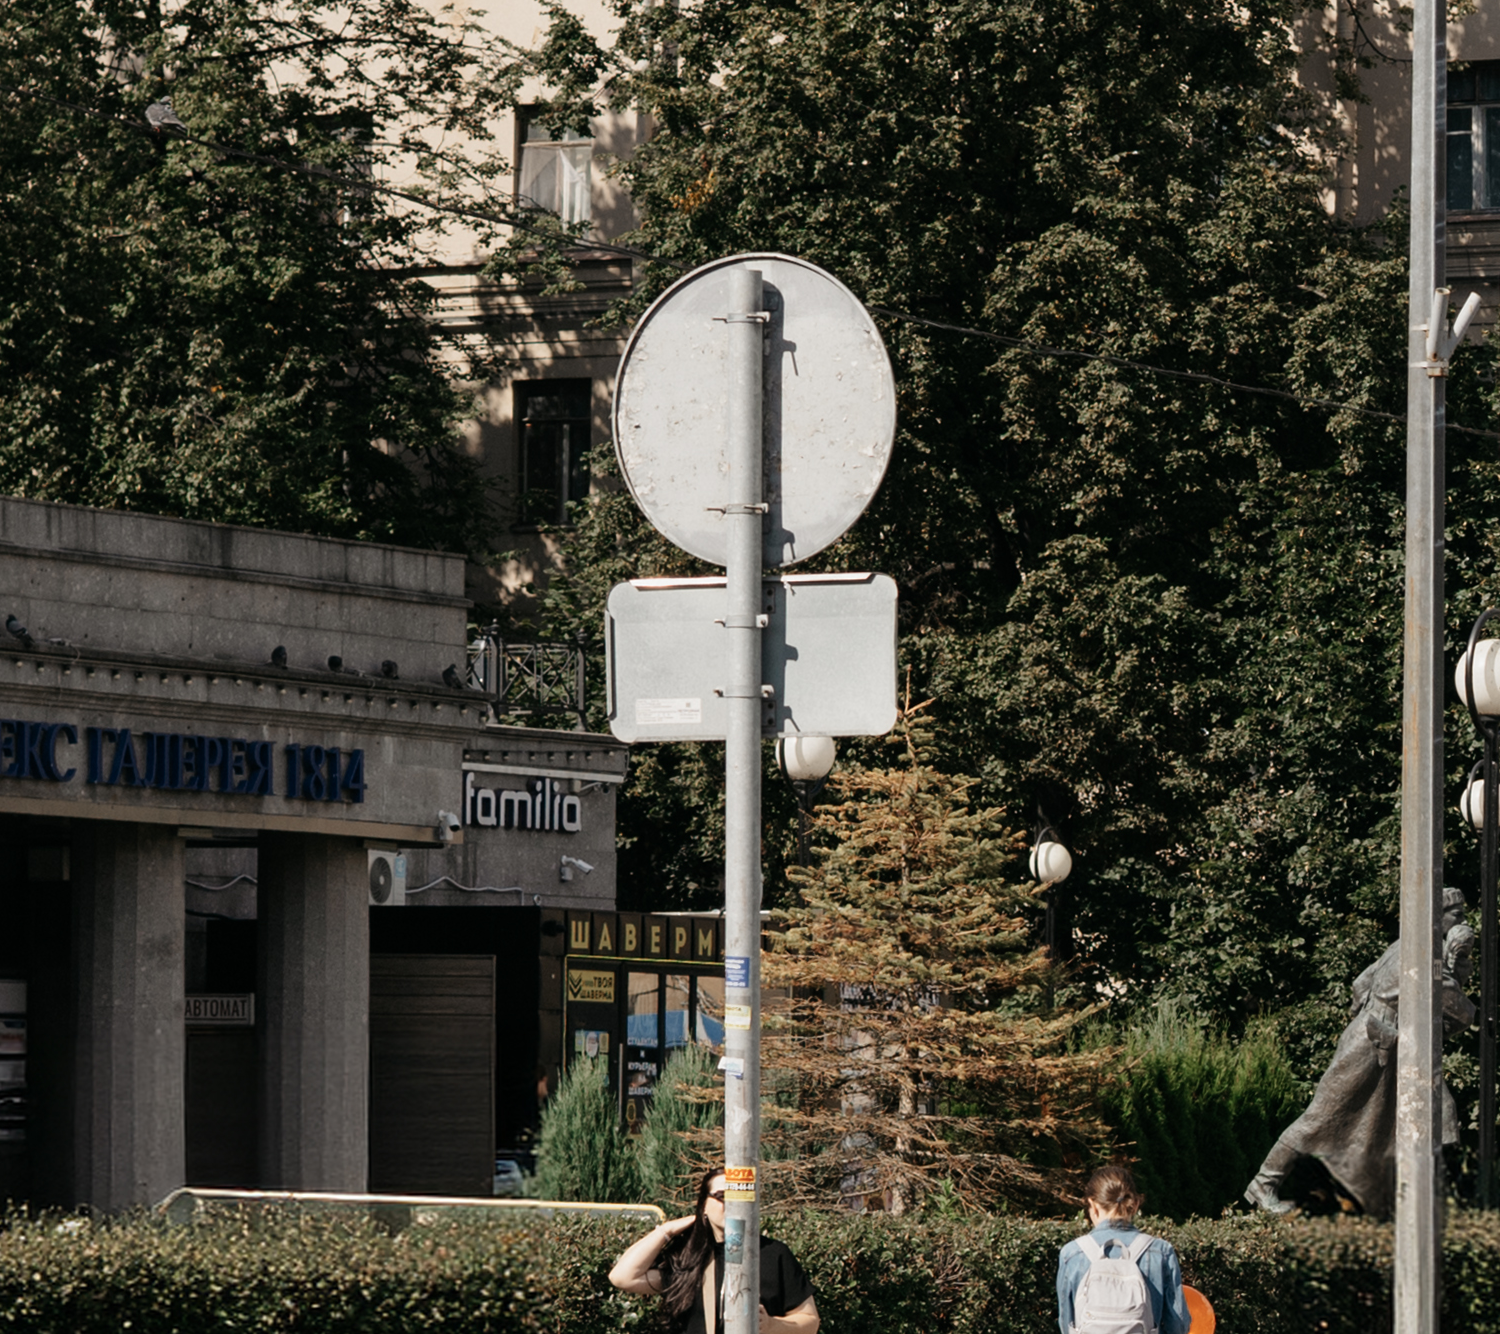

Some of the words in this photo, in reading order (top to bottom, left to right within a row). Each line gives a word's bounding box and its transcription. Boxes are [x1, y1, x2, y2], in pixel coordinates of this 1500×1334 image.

[86, 726, 277, 796] ГАЛЕРЕЯ
[285, 742, 368, 804] 1814
[466, 772, 581, 832] familia
[570, 920, 713, 957] ШАВЕРМ
[580, 989, 612, 999] ШАВЕРМА
[593, 976, 613, 988] ТВОЯ
[185, 999, 247, 1017] АВТОМАТ
